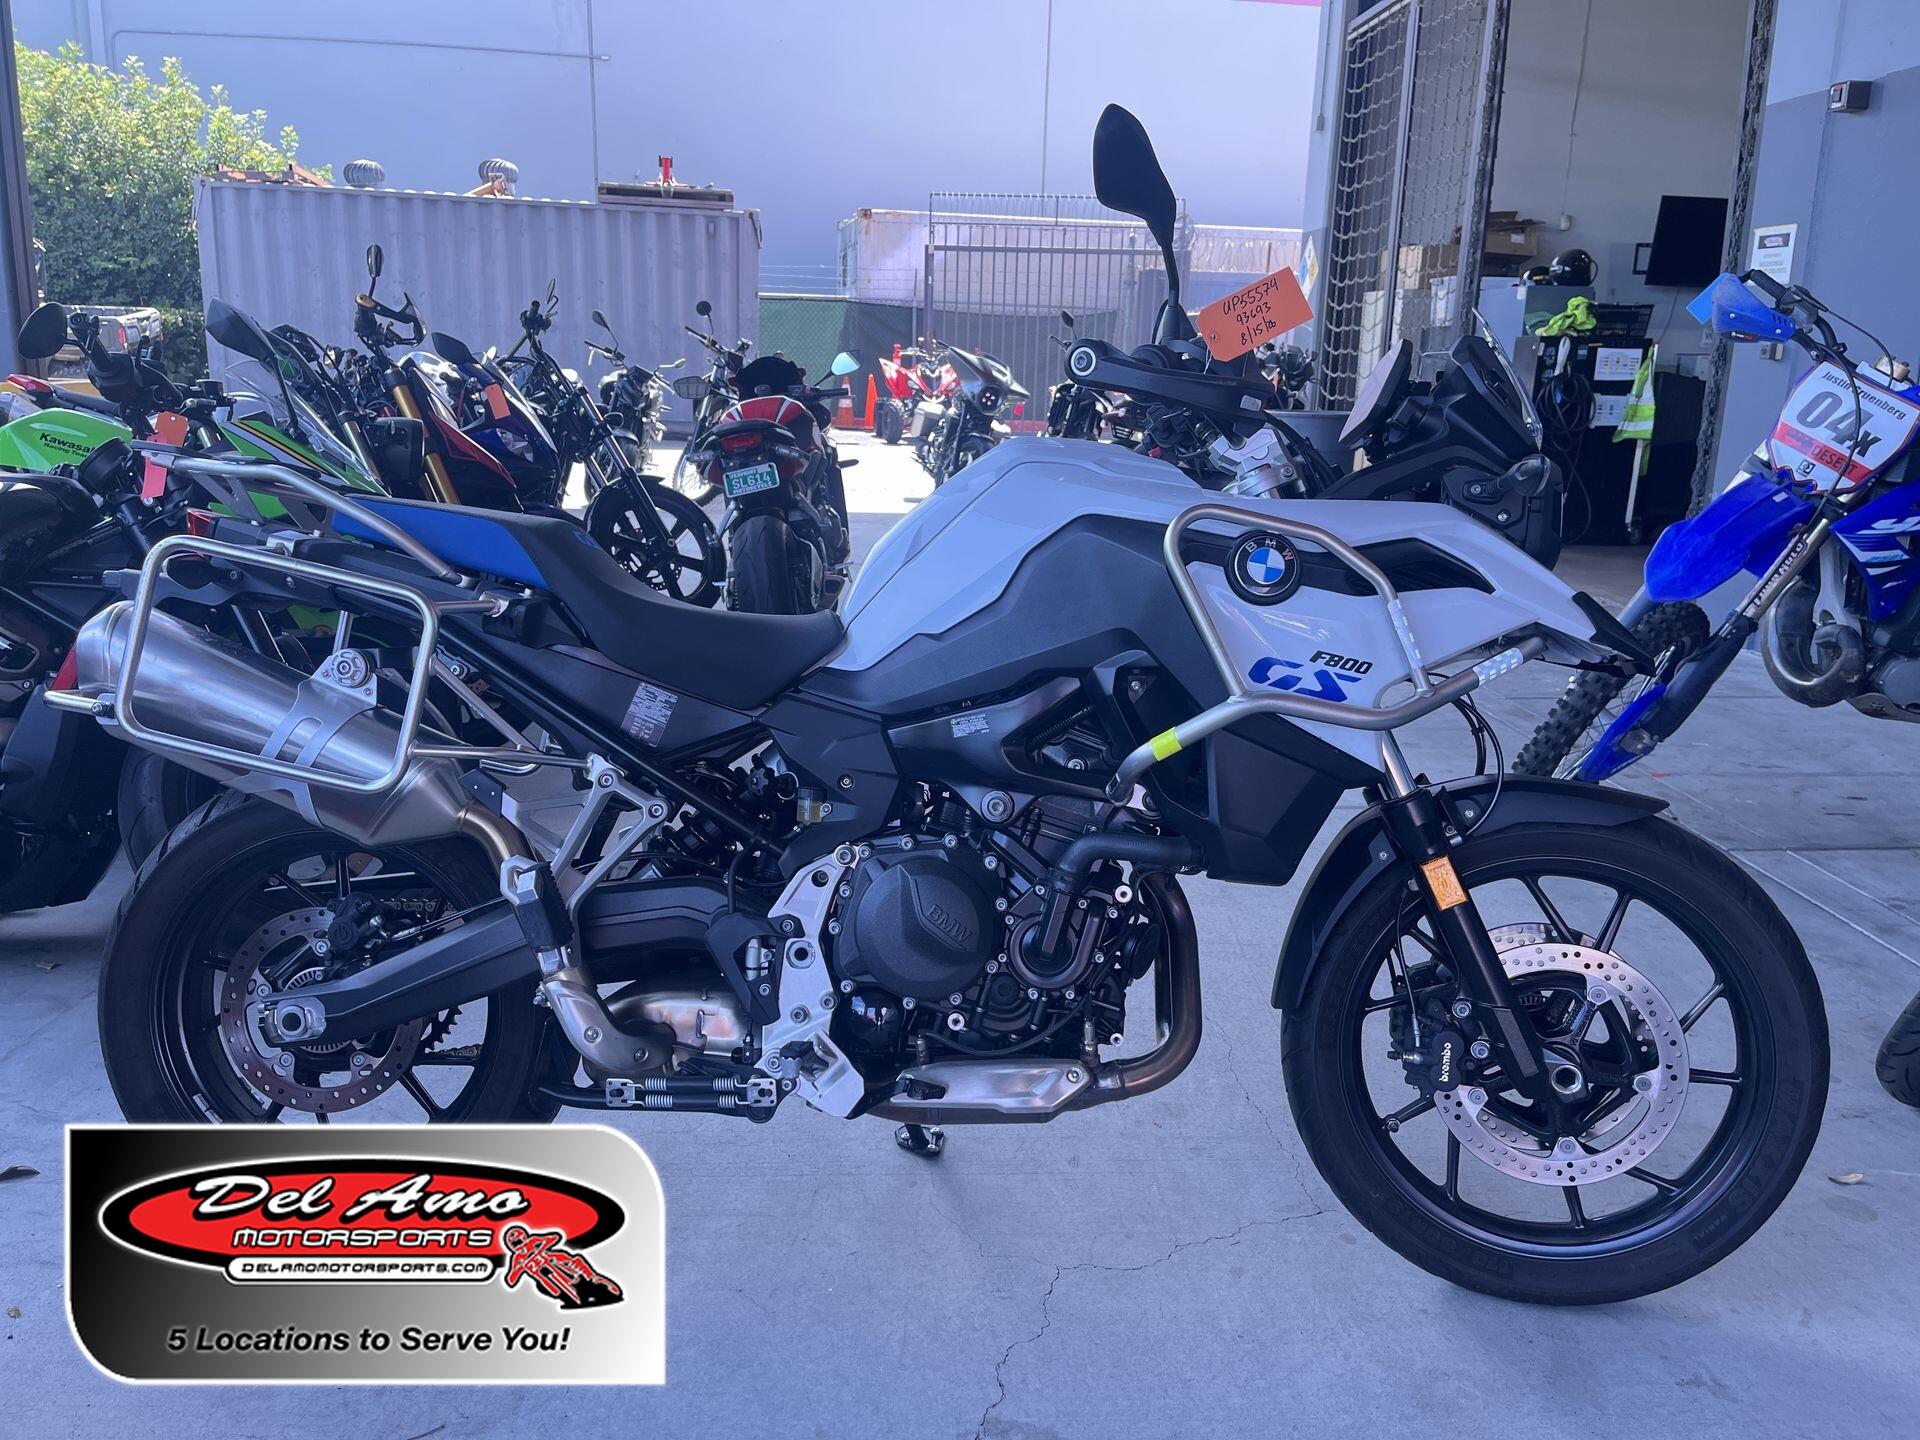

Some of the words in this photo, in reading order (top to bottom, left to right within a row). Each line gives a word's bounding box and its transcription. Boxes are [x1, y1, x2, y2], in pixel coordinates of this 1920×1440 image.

[1821, 371, 1850, 391] Justin
[43, 442, 70, 454] Racing
[1811, 444, 1858, 477] DESET
[732, 472, 771, 490] SL614
[733, 481, 773, 495] MOTORCYCLE
[1244, 537, 1294, 561] BMW
[1309, 650, 1373, 675] F800
[1248, 656, 1362, 702] GS
[927, 904, 974, 943] BMW
[1439, 1042, 1452, 1083] brembo
